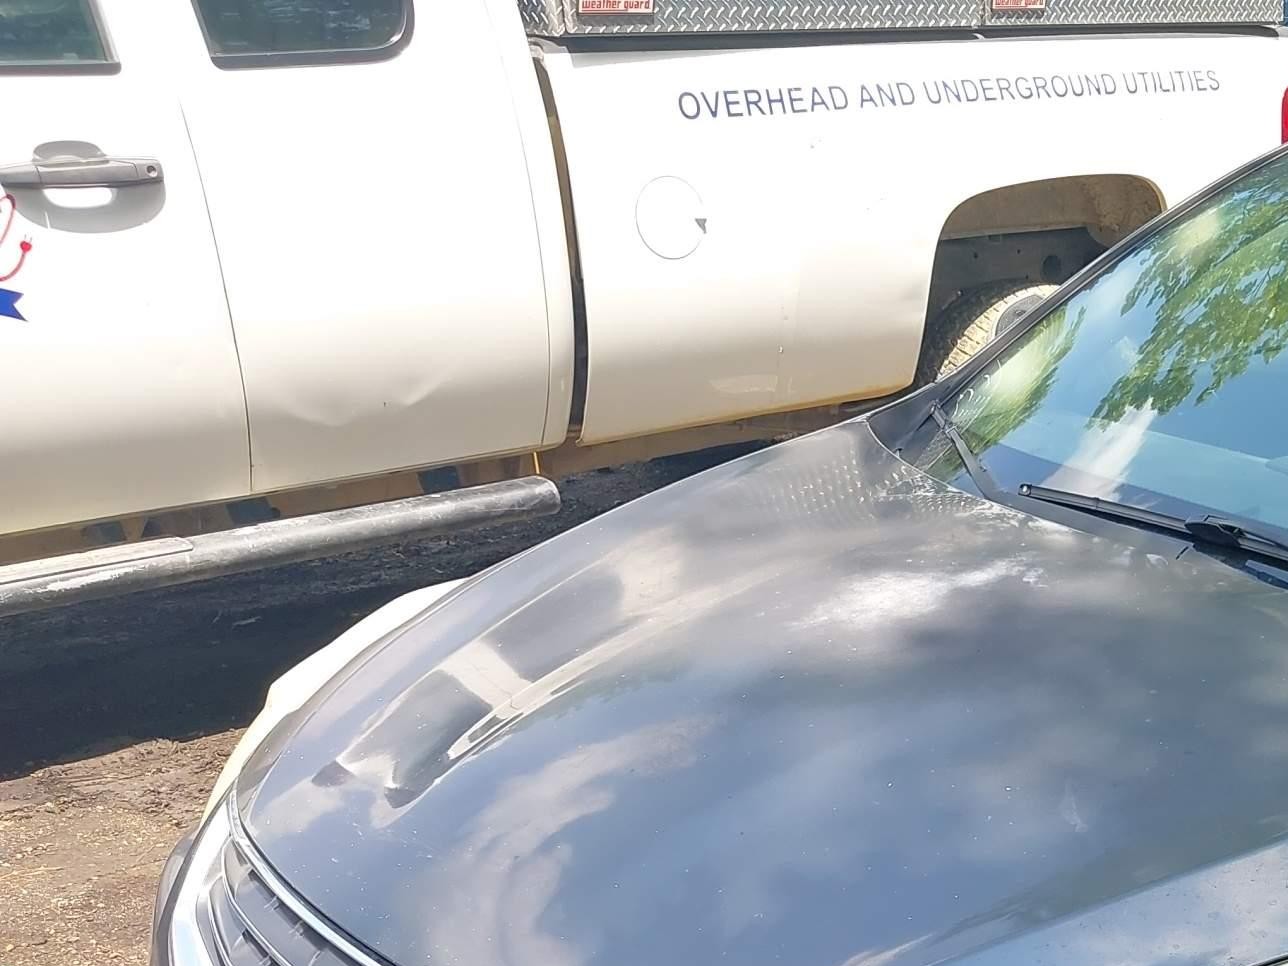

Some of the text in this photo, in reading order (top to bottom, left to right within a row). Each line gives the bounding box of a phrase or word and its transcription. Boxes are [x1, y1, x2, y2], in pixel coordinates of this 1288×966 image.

[678, 70, 1220, 120] OVERHEAD AND UNDERGROUND UTILITIES
